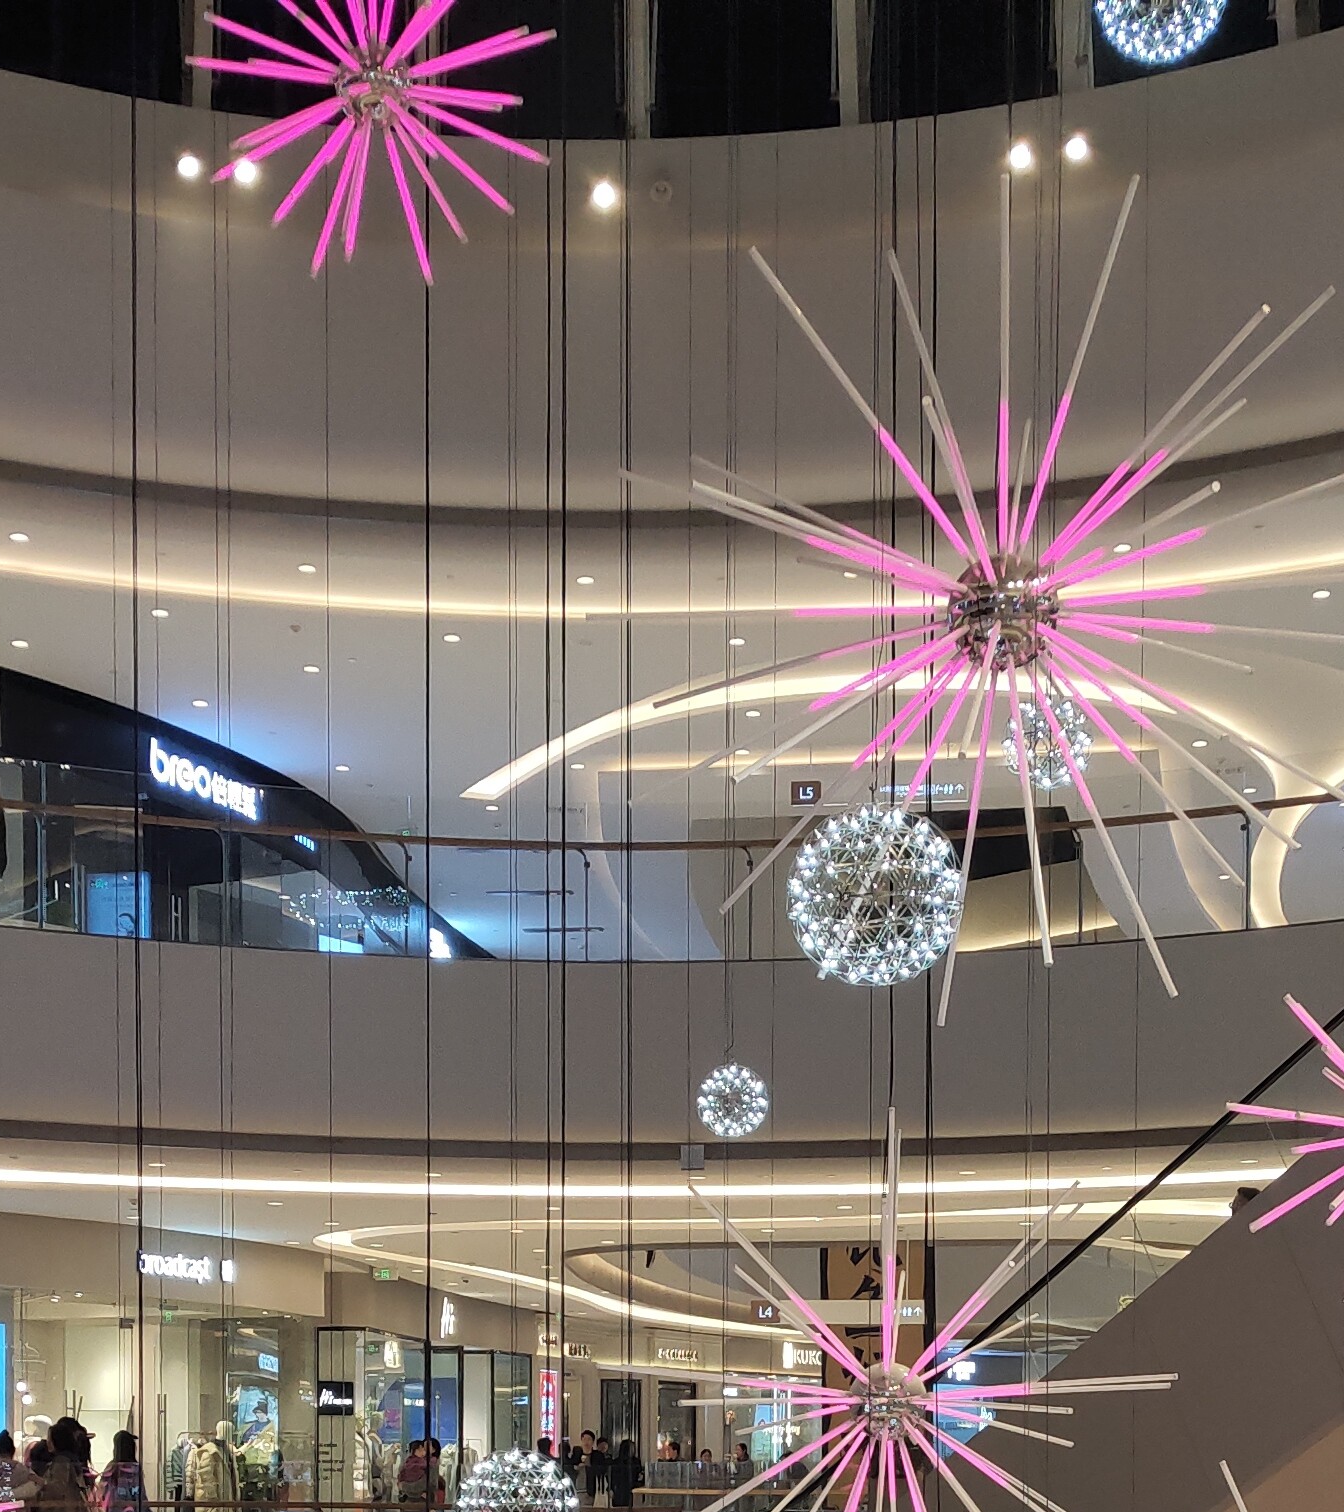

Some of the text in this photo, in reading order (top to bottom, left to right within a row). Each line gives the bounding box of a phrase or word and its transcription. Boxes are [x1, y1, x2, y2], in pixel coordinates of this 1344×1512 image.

[149, 736, 212, 799] breo
[799, 786, 814, 800] L5
[758, 1306, 773, 1319] L4
